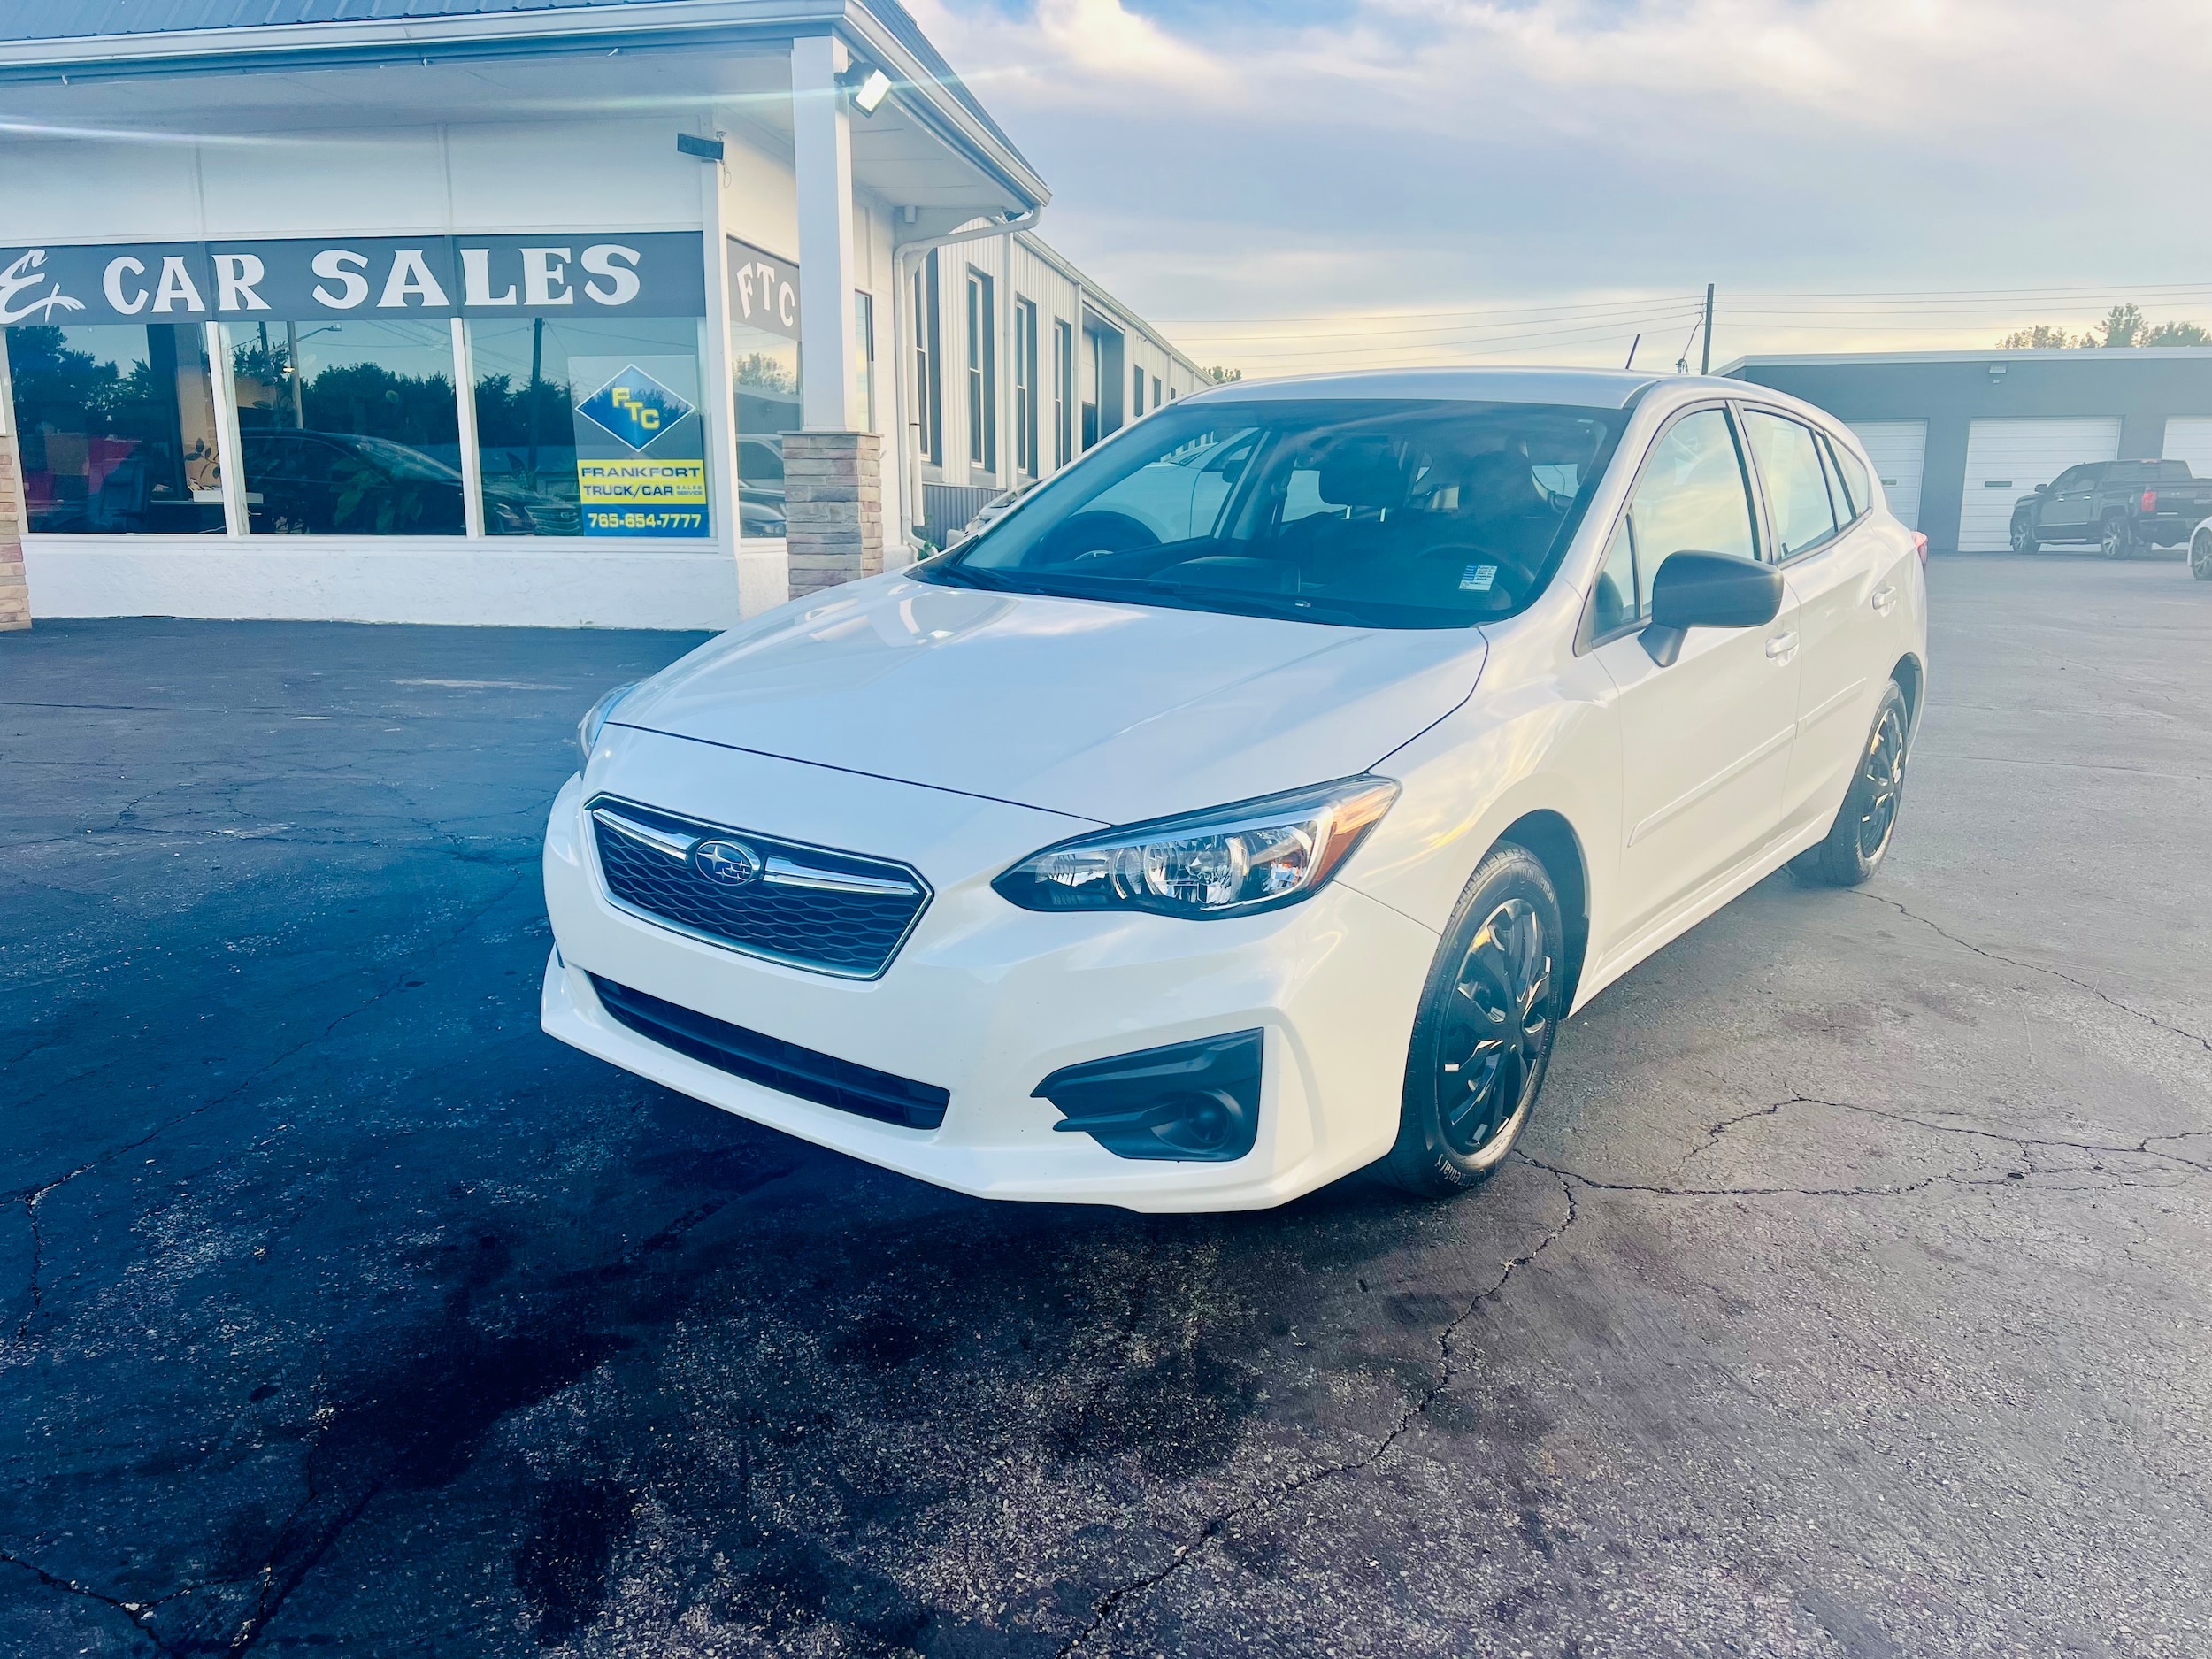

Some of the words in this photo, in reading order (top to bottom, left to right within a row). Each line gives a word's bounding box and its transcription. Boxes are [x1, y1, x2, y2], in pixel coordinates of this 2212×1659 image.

[102, 253, 272, 315] CAR
[311, 243, 641, 310] SALES
[736, 262, 795, 327] FTC
[612, 387, 660, 429] FTC
[581, 466, 700, 478] FRANKFORT
[583, 485, 674, 499] TRUCK/CAR
[588, 512, 702, 528] 765-654-7777
